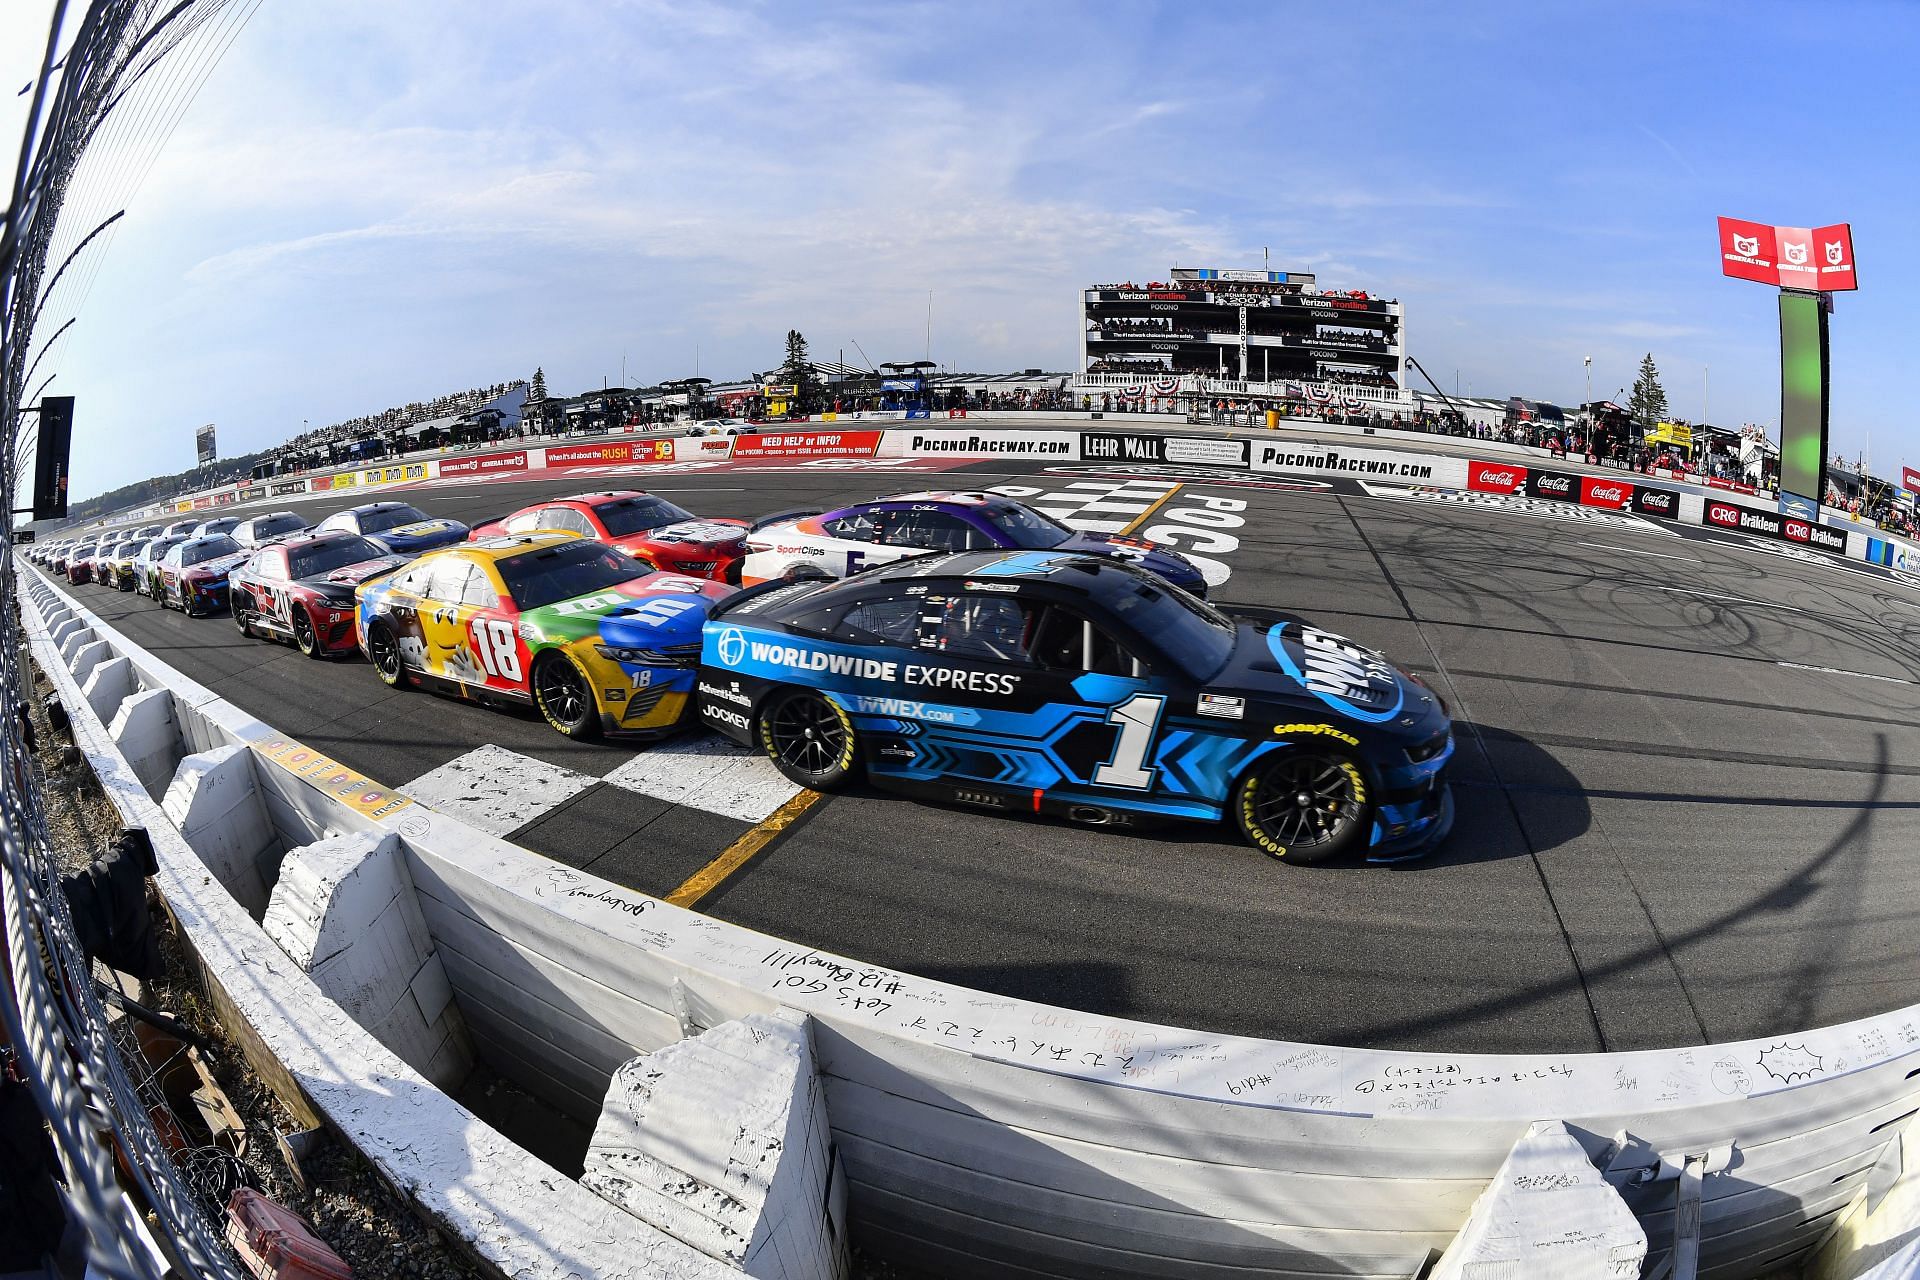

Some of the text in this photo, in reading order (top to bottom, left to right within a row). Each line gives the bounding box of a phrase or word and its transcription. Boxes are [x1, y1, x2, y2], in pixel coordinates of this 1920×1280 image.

[1725, 254, 1755, 265] GENERAL
[1310, 350, 1338, 358] POCONO
[761, 436, 842, 447] NEED HELP or INFO?
[1085, 435, 1118, 458] LEHR
[1124, 437, 1160, 460] WALL
[602, 447, 628, 460] RUSH
[1600, 458, 1630, 470] RHEEM.COM
[1480, 470, 1514, 486] Coca-Cola
[1537, 476, 1570, 491] Coca-Cola
[1591, 486, 1622, 502] Coca-Cola
[1642, 492, 1671, 508] Coca-Cola
[1711, 507, 1737, 524] CRC
[1786, 524, 1808, 538] CRC
[329, 612, 340, 622] 20
[470, 618, 523, 683] 18
[750, 641, 898, 682] WORLDWIDE
[631, 670, 652, 690] 18
[699, 682, 752, 708] AdventHealth
[702, 704, 750, 730] JOCKEY
[1273, 722, 1360, 746] GOODYEAR
[1093, 695, 1164, 790] 1
[366, 792, 376, 802] m
[858, 972, 906, 995] #12
[836, 986, 892, 1016] Let's
